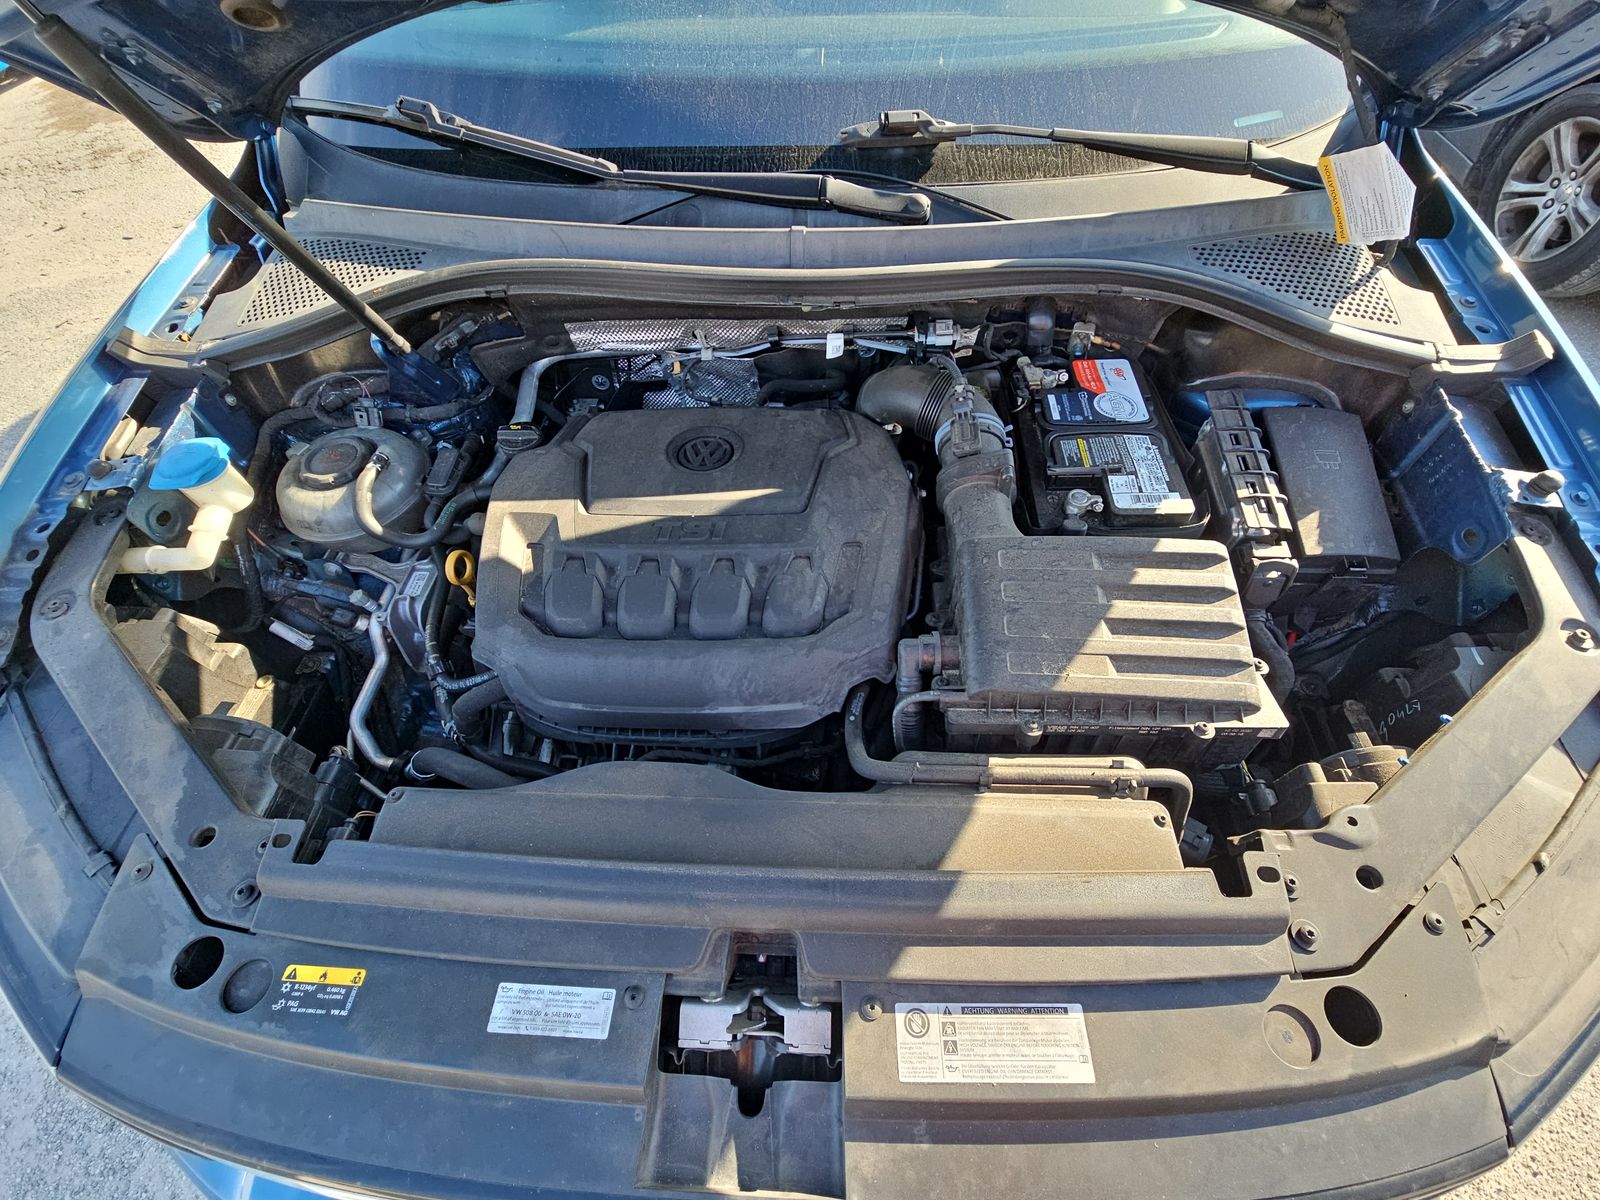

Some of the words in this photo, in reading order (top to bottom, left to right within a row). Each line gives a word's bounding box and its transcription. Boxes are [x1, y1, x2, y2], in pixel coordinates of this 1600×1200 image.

[1323, 164, 1338, 206] VIOLATION
[1334, 206, 1345, 239] PARKING
[652, 520, 728, 541] TSI
[517, 988, 537, 997] Engine
[536, 988, 545, 996] Oil
[548, 989, 563, 997] Huile
[522, 1008, 534, 1016] 508
[533, 1009, 542, 1017] 00
[963, 1007, 995, 1015] ACHTUNG
[996, 1007, 1028, 1015] WARNING
[1030, 1007, 1065, 1015] ATTENTION
